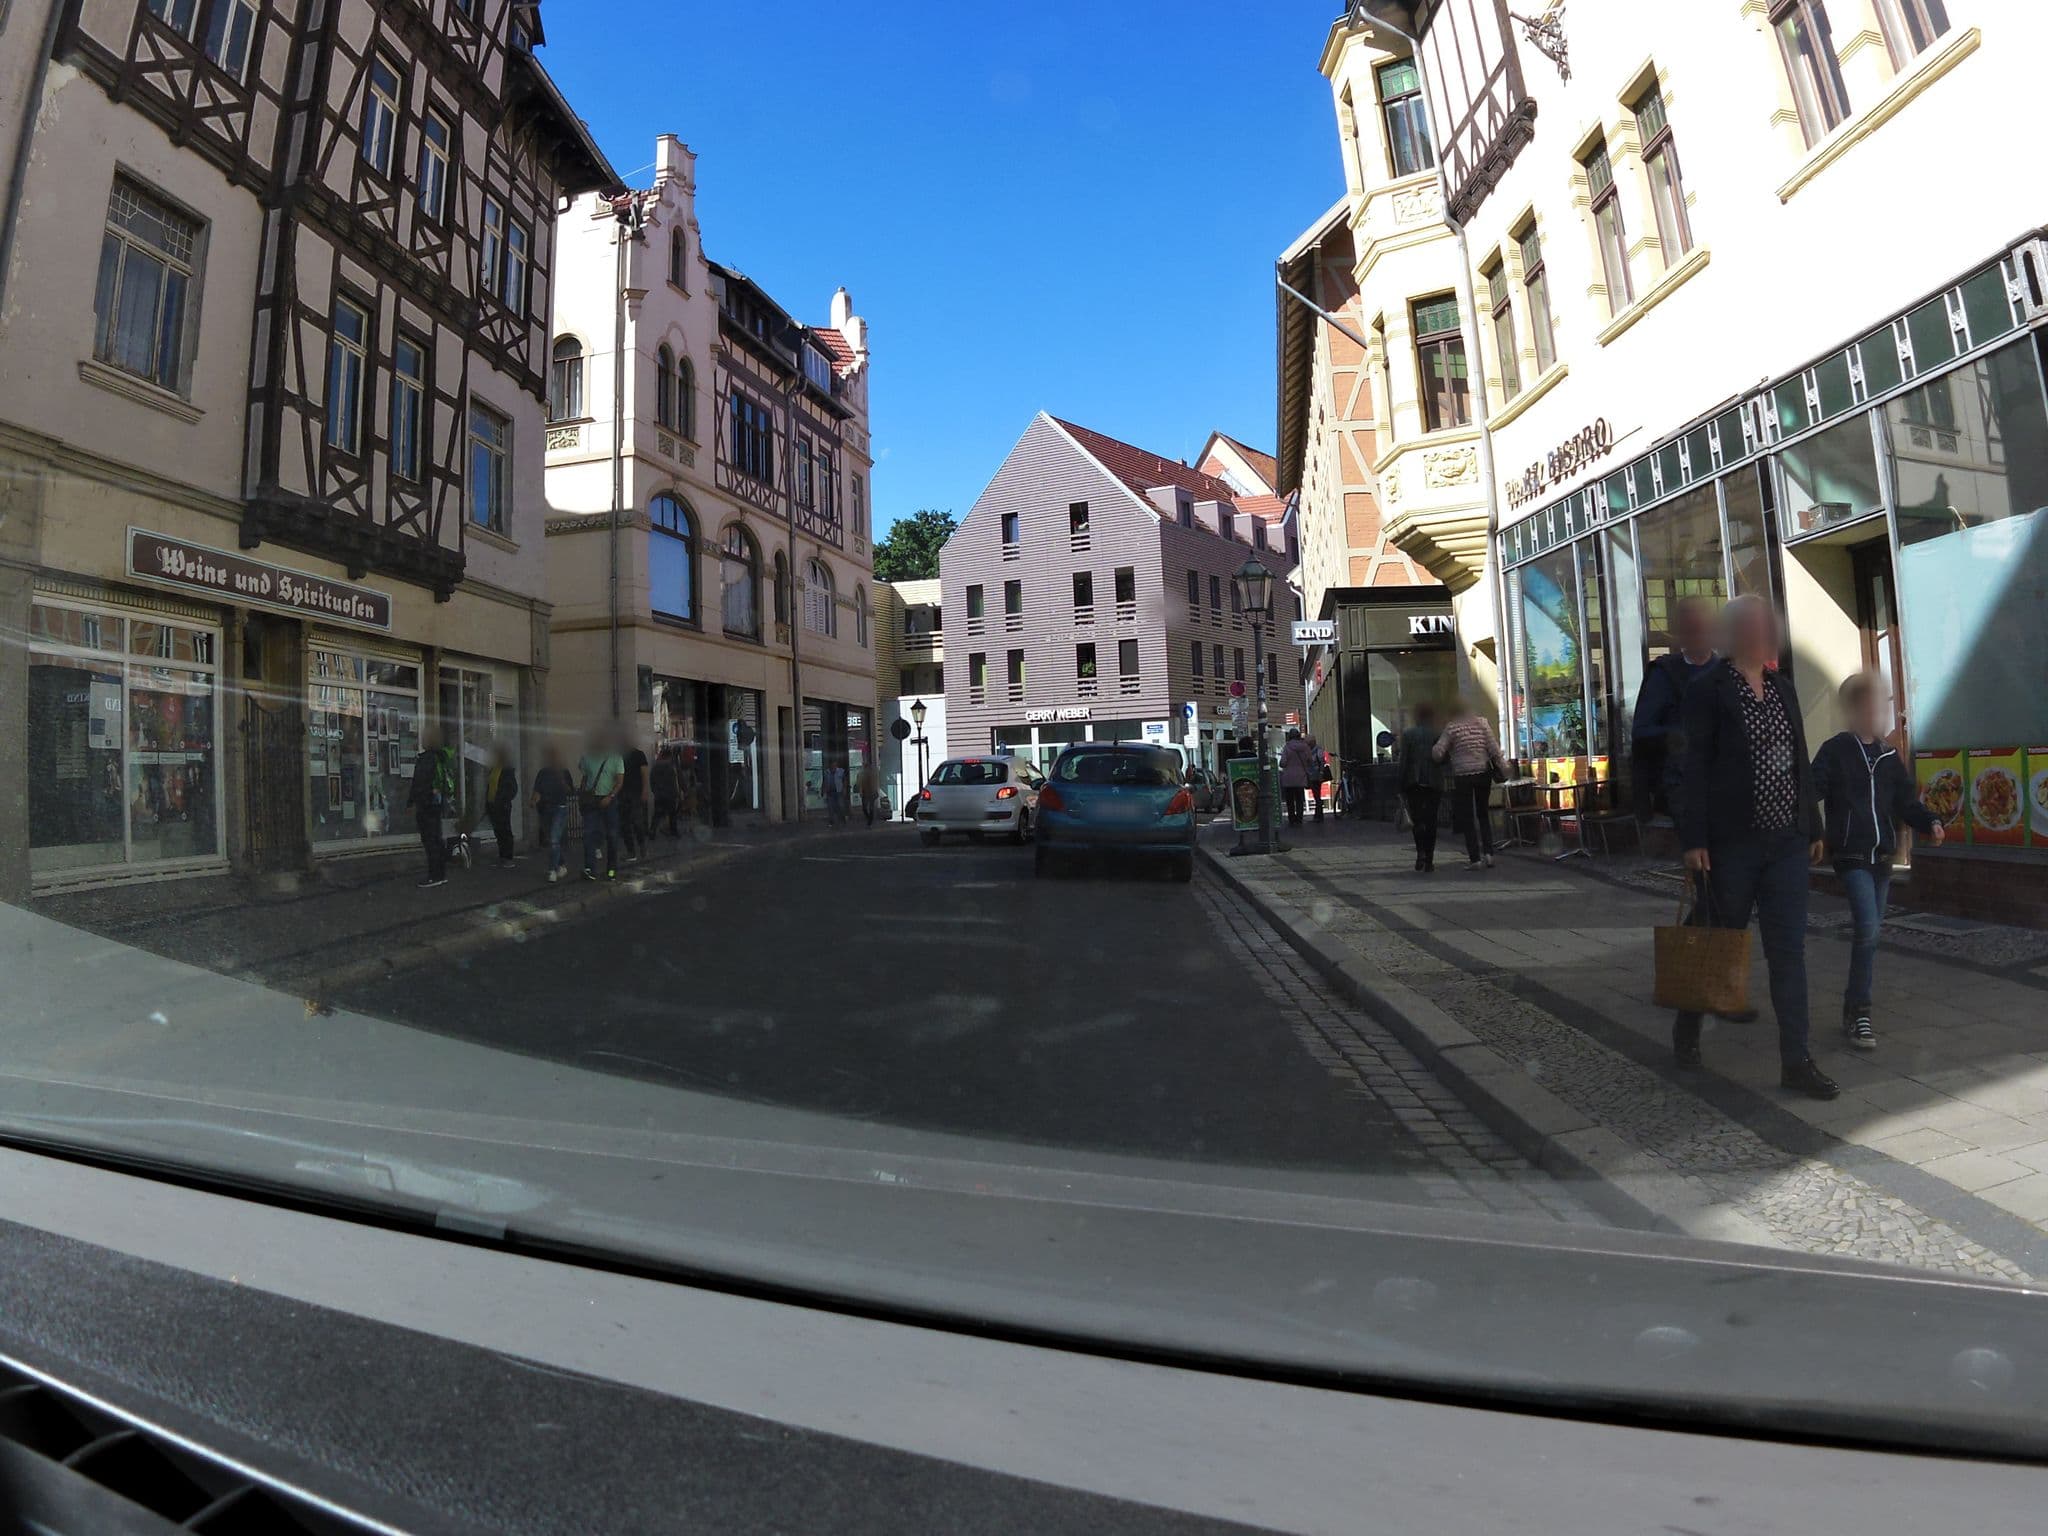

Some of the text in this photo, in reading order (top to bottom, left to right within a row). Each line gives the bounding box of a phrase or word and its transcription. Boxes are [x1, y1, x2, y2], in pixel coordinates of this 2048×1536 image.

[1547, 417, 1607, 480] BISTRO
[156, 546, 227, 586] Weine
[234, 572, 272, 596] und
[1294, 627, 1332, 640] KIND
[1025, 707, 1090, 721] GERRY WEBER
